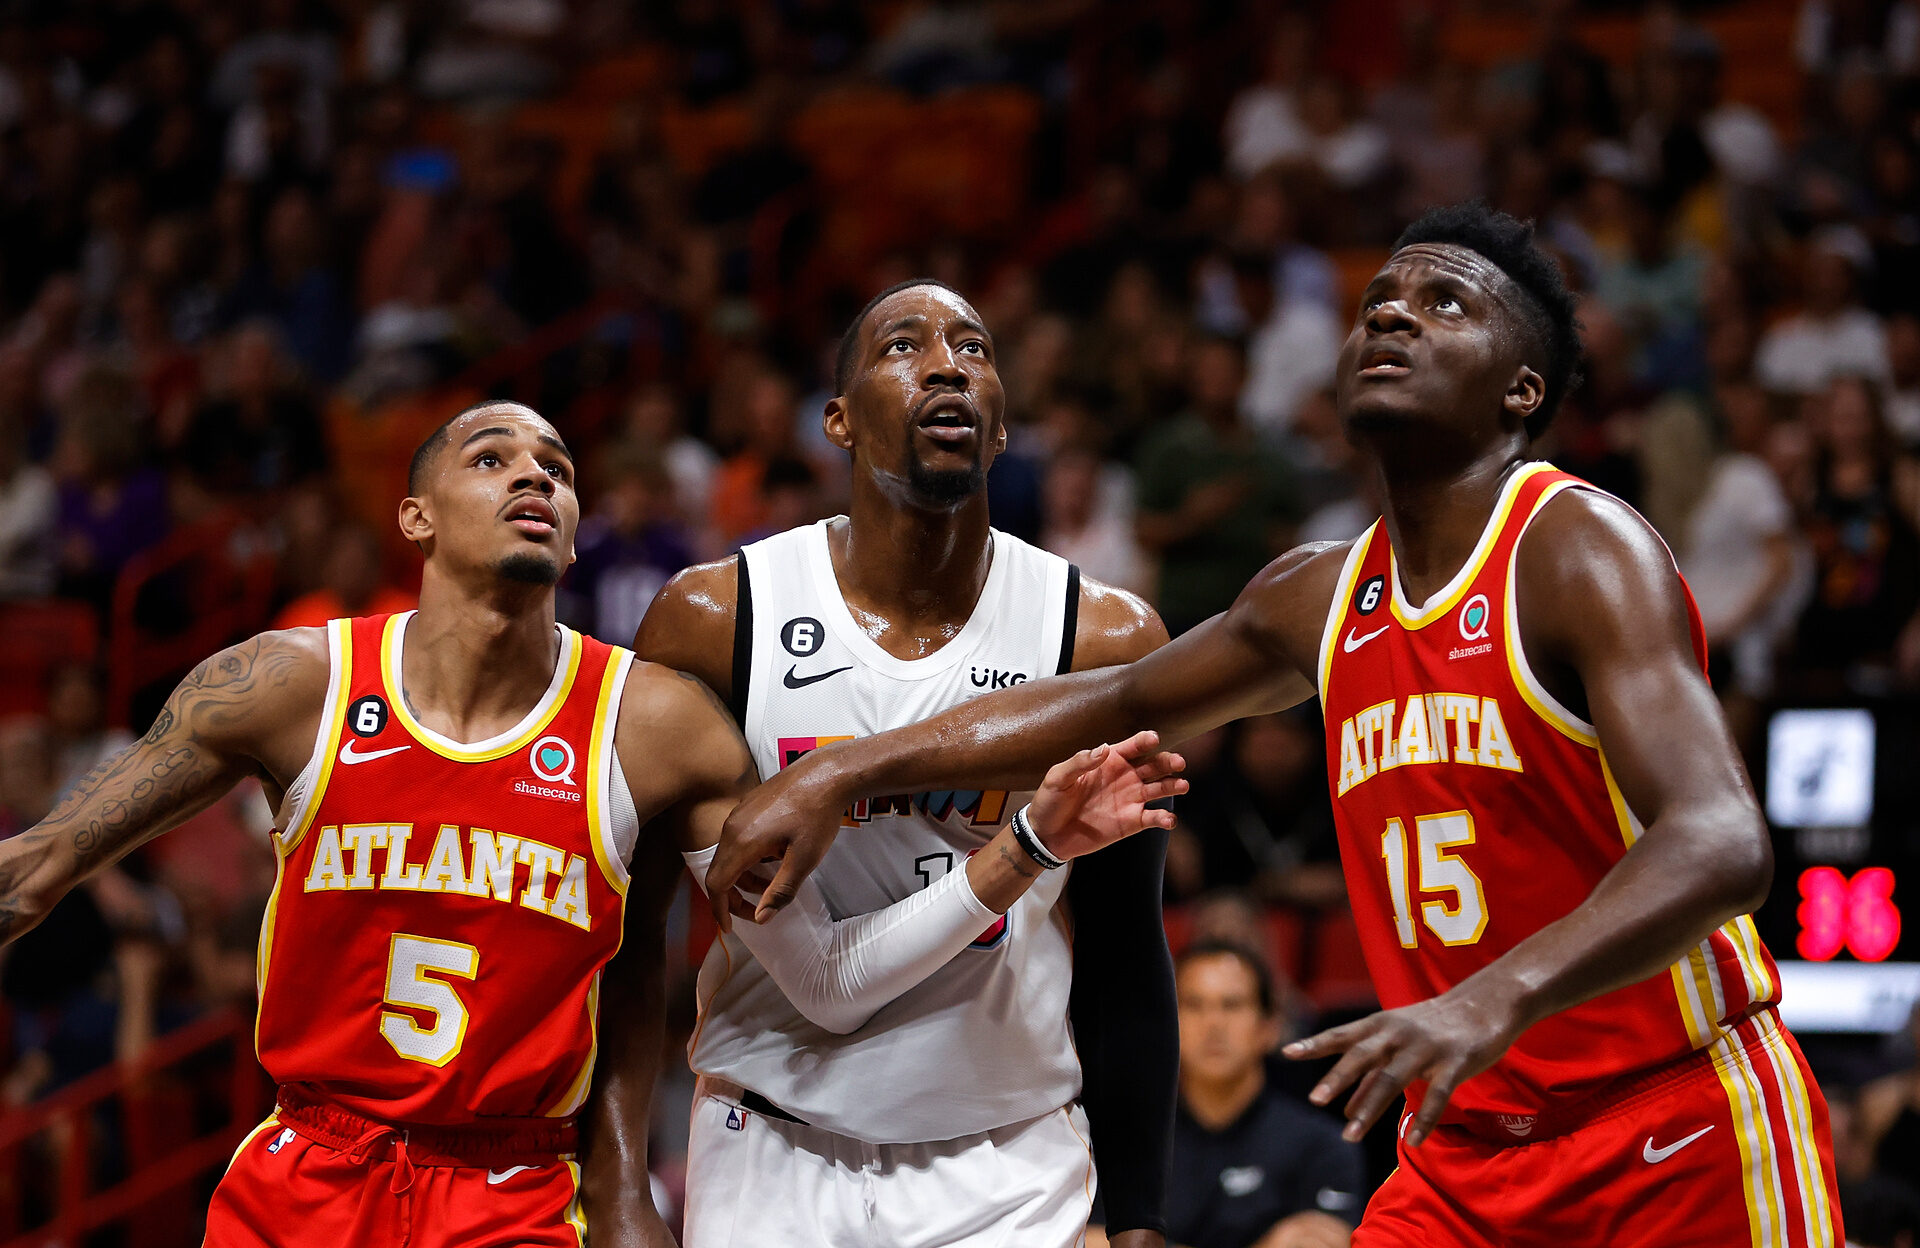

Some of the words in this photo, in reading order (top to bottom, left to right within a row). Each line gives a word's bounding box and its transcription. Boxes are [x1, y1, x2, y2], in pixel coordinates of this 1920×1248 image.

[1361, 581, 1382, 610] 6
[790, 623, 815, 652] 6
[1448, 643, 1492, 660] sharecare
[356, 701, 380, 732] 6
[1337, 692, 1524, 798] ATLANTA
[514, 780, 580, 801] sharecare
[304, 823, 592, 932] ATLANTA
[1381, 809, 1490, 948] 15
[380, 932, 480, 1068] 5
